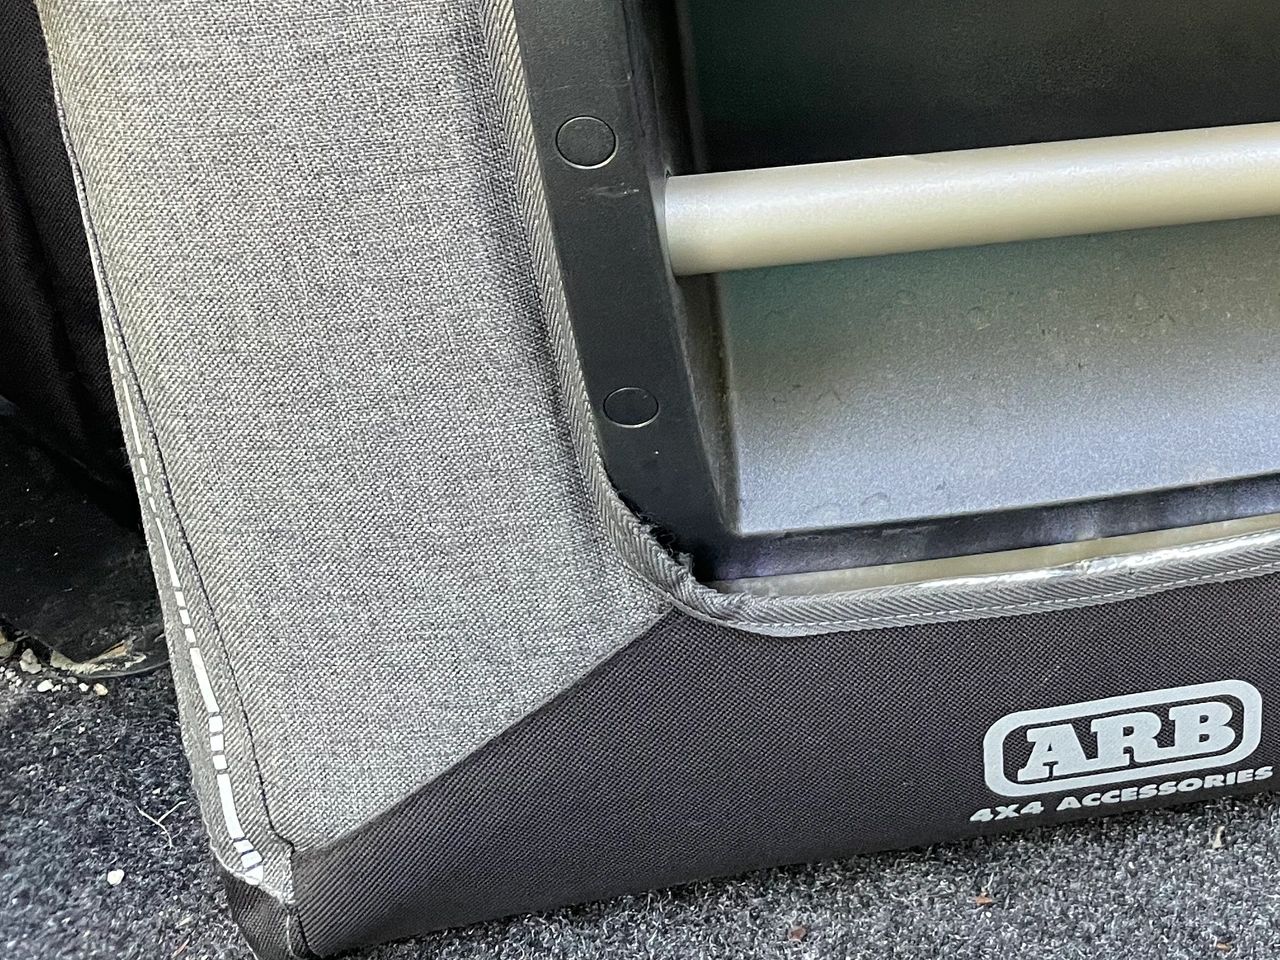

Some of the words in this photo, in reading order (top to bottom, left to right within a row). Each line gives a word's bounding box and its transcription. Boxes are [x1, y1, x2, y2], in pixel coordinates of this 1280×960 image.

[1017, 701, 1236, 782] ARB
[969, 801, 1044, 822] 4X4
[1056, 766, 1274, 811] ACCESSORIES
